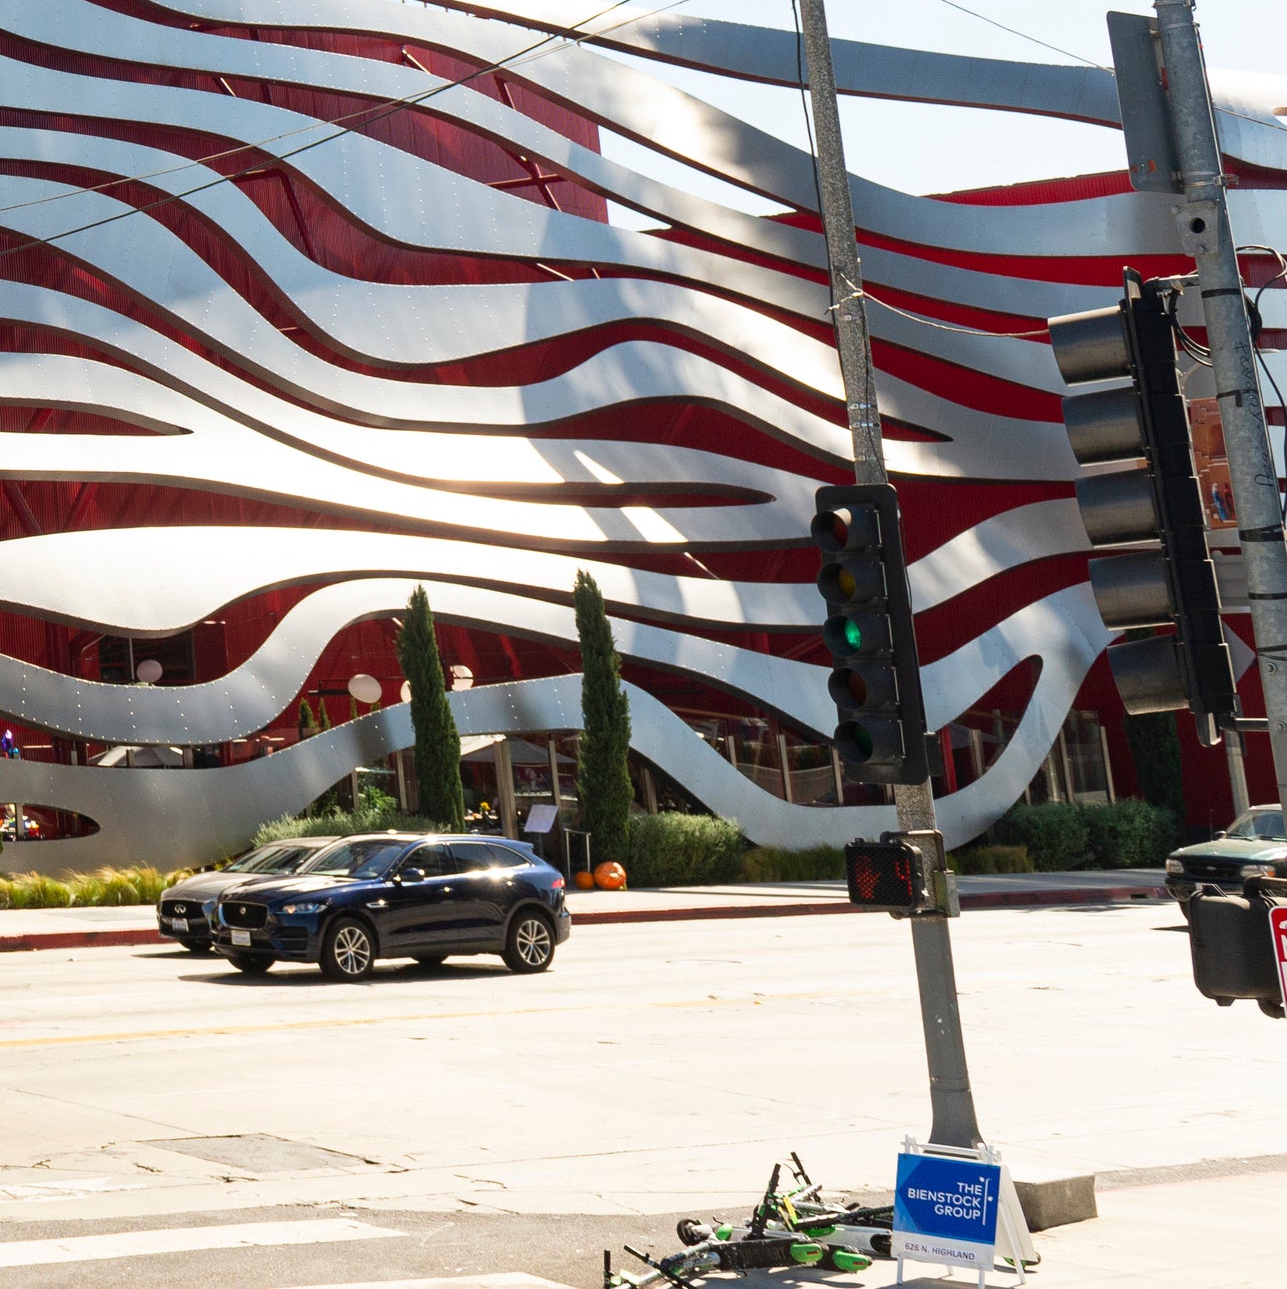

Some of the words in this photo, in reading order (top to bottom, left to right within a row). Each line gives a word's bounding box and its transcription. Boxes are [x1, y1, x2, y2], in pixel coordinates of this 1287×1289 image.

[957, 1181, 983, 1196] THE
[907, 1187, 982, 1209] BIENSTOCK
[934, 1204, 981, 1220] GROUP
[920, 1244, 930, 1254] N.
[931, 1247, 975, 1261] HIGHLAND
